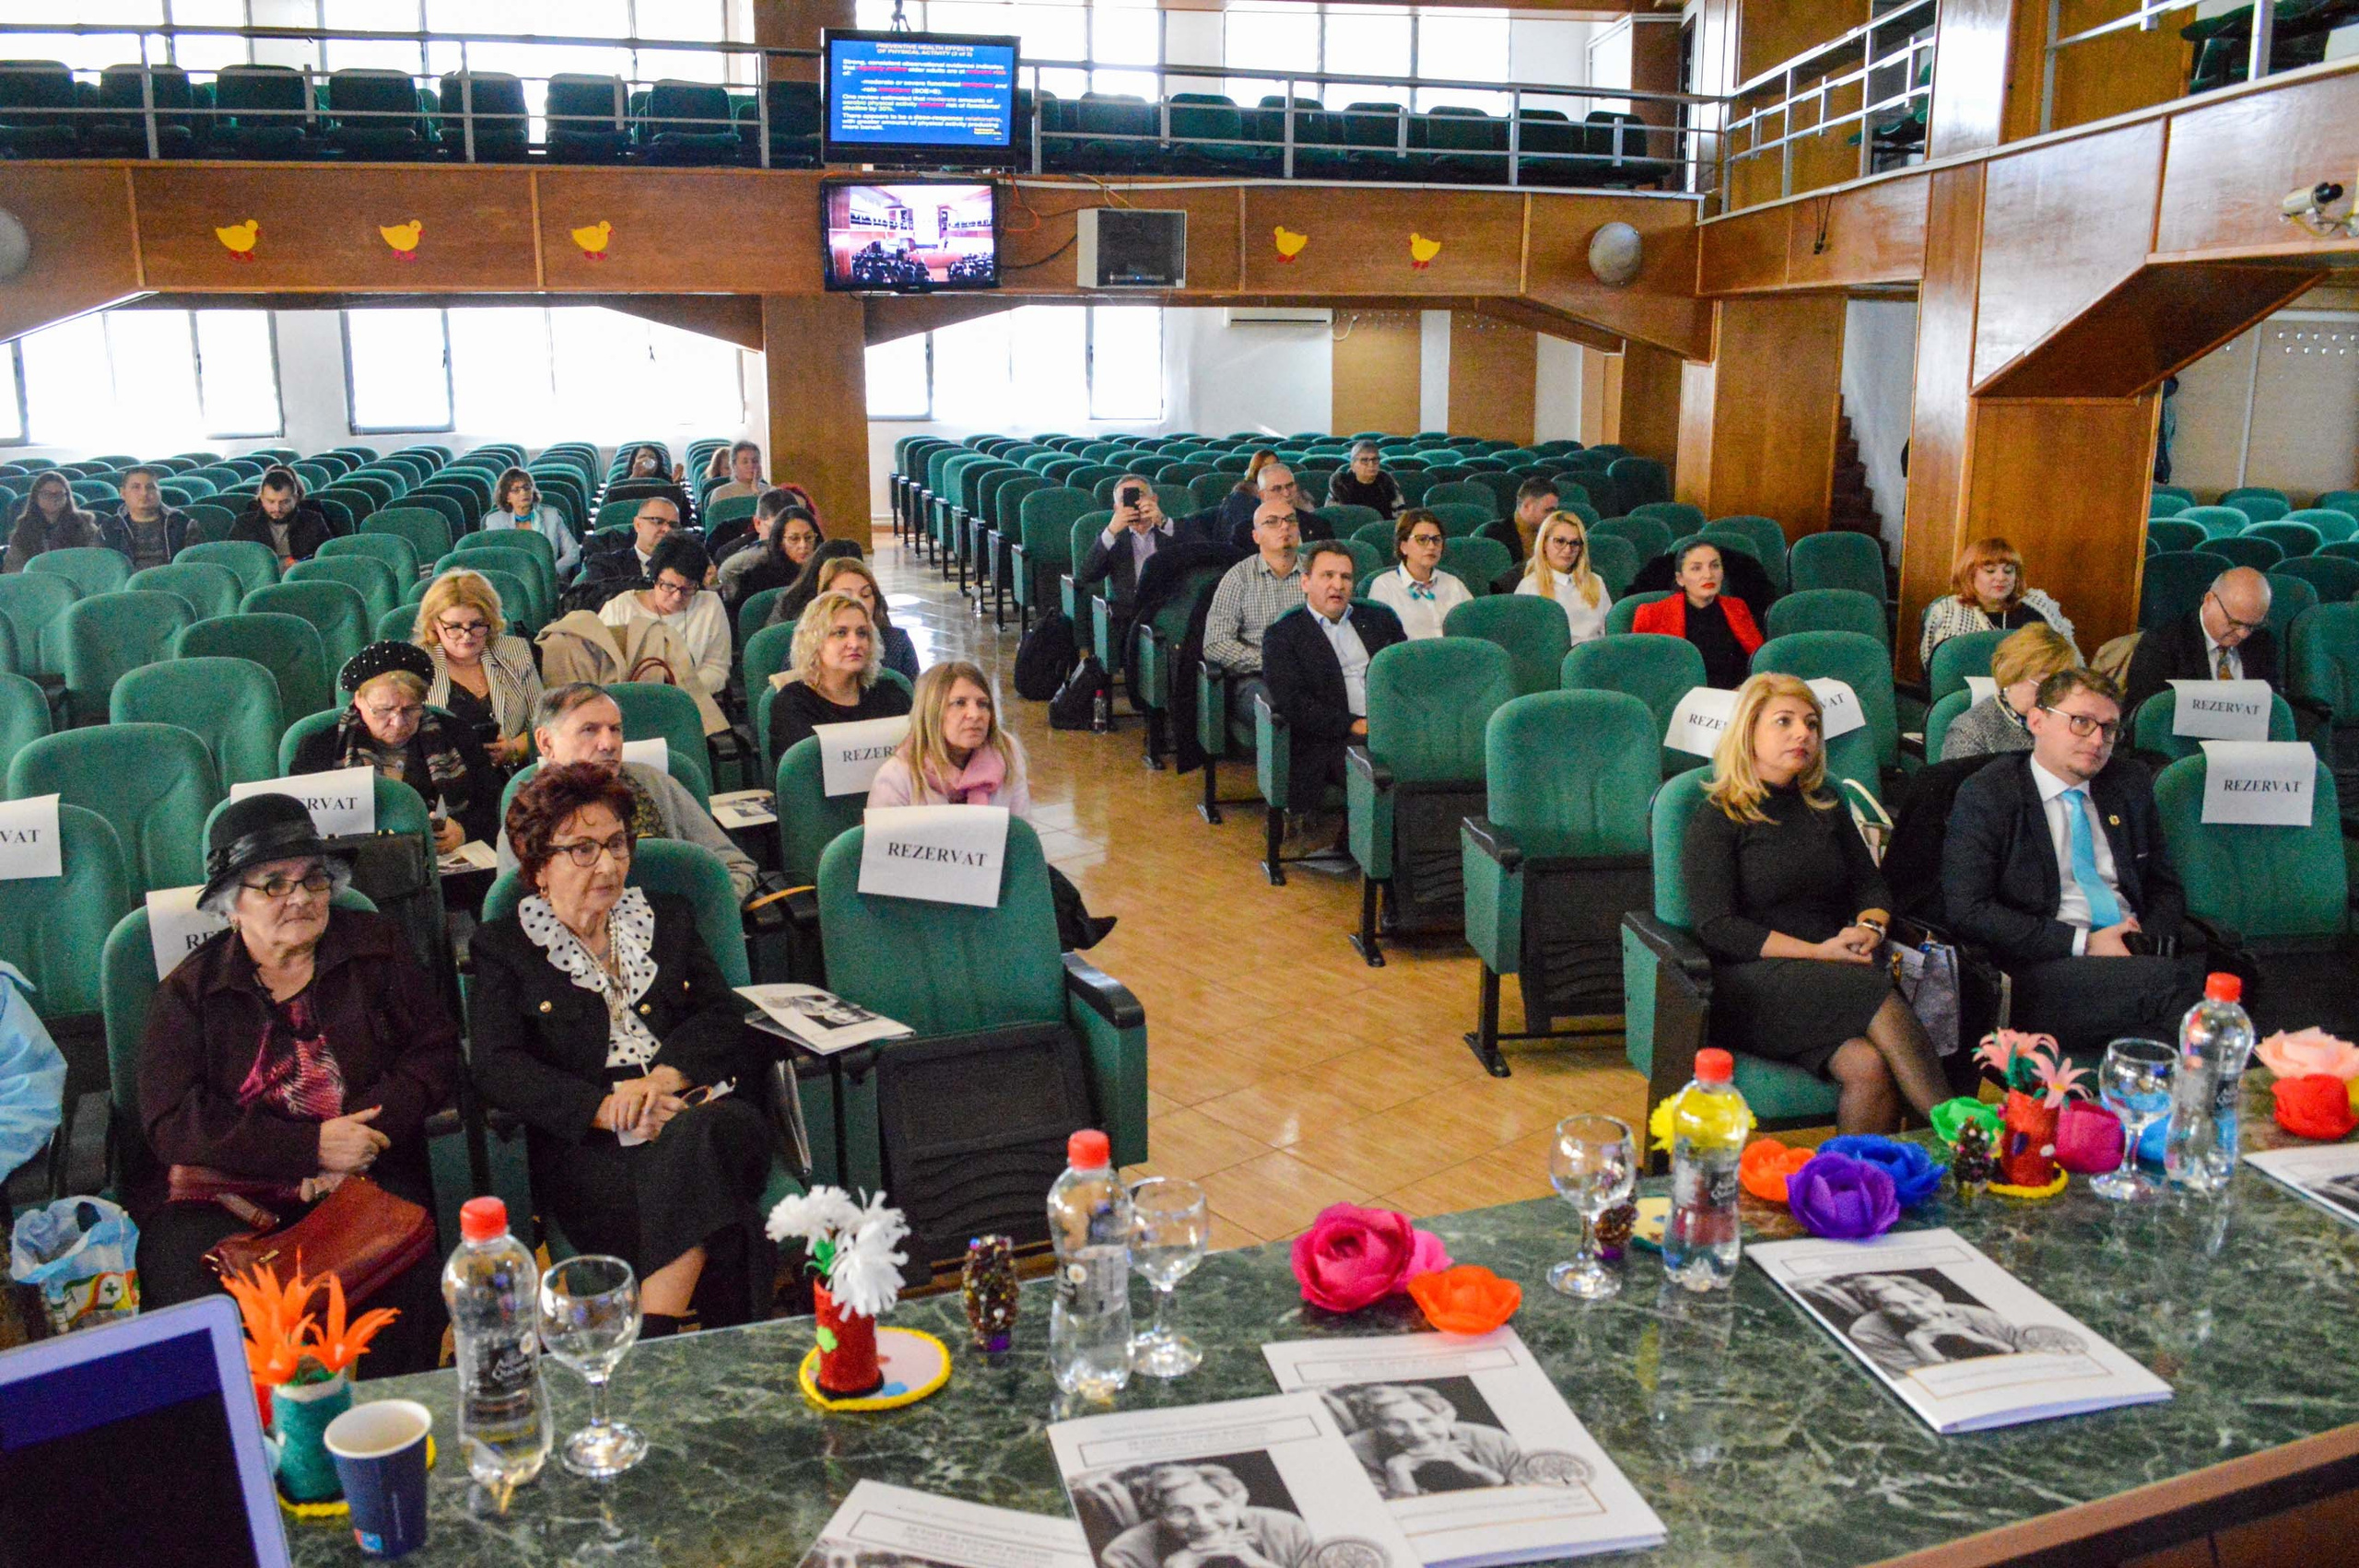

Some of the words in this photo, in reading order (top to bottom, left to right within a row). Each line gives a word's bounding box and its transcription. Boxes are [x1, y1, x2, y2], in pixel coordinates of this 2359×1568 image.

[2192, 698, 2260, 715] REZERVAT
[1689, 713, 1728, 731] REZE
[842, 744, 898, 762] REZER
[2224, 778, 2302, 793] REZERVAT
[887, 842, 989, 867] REZERVAT
